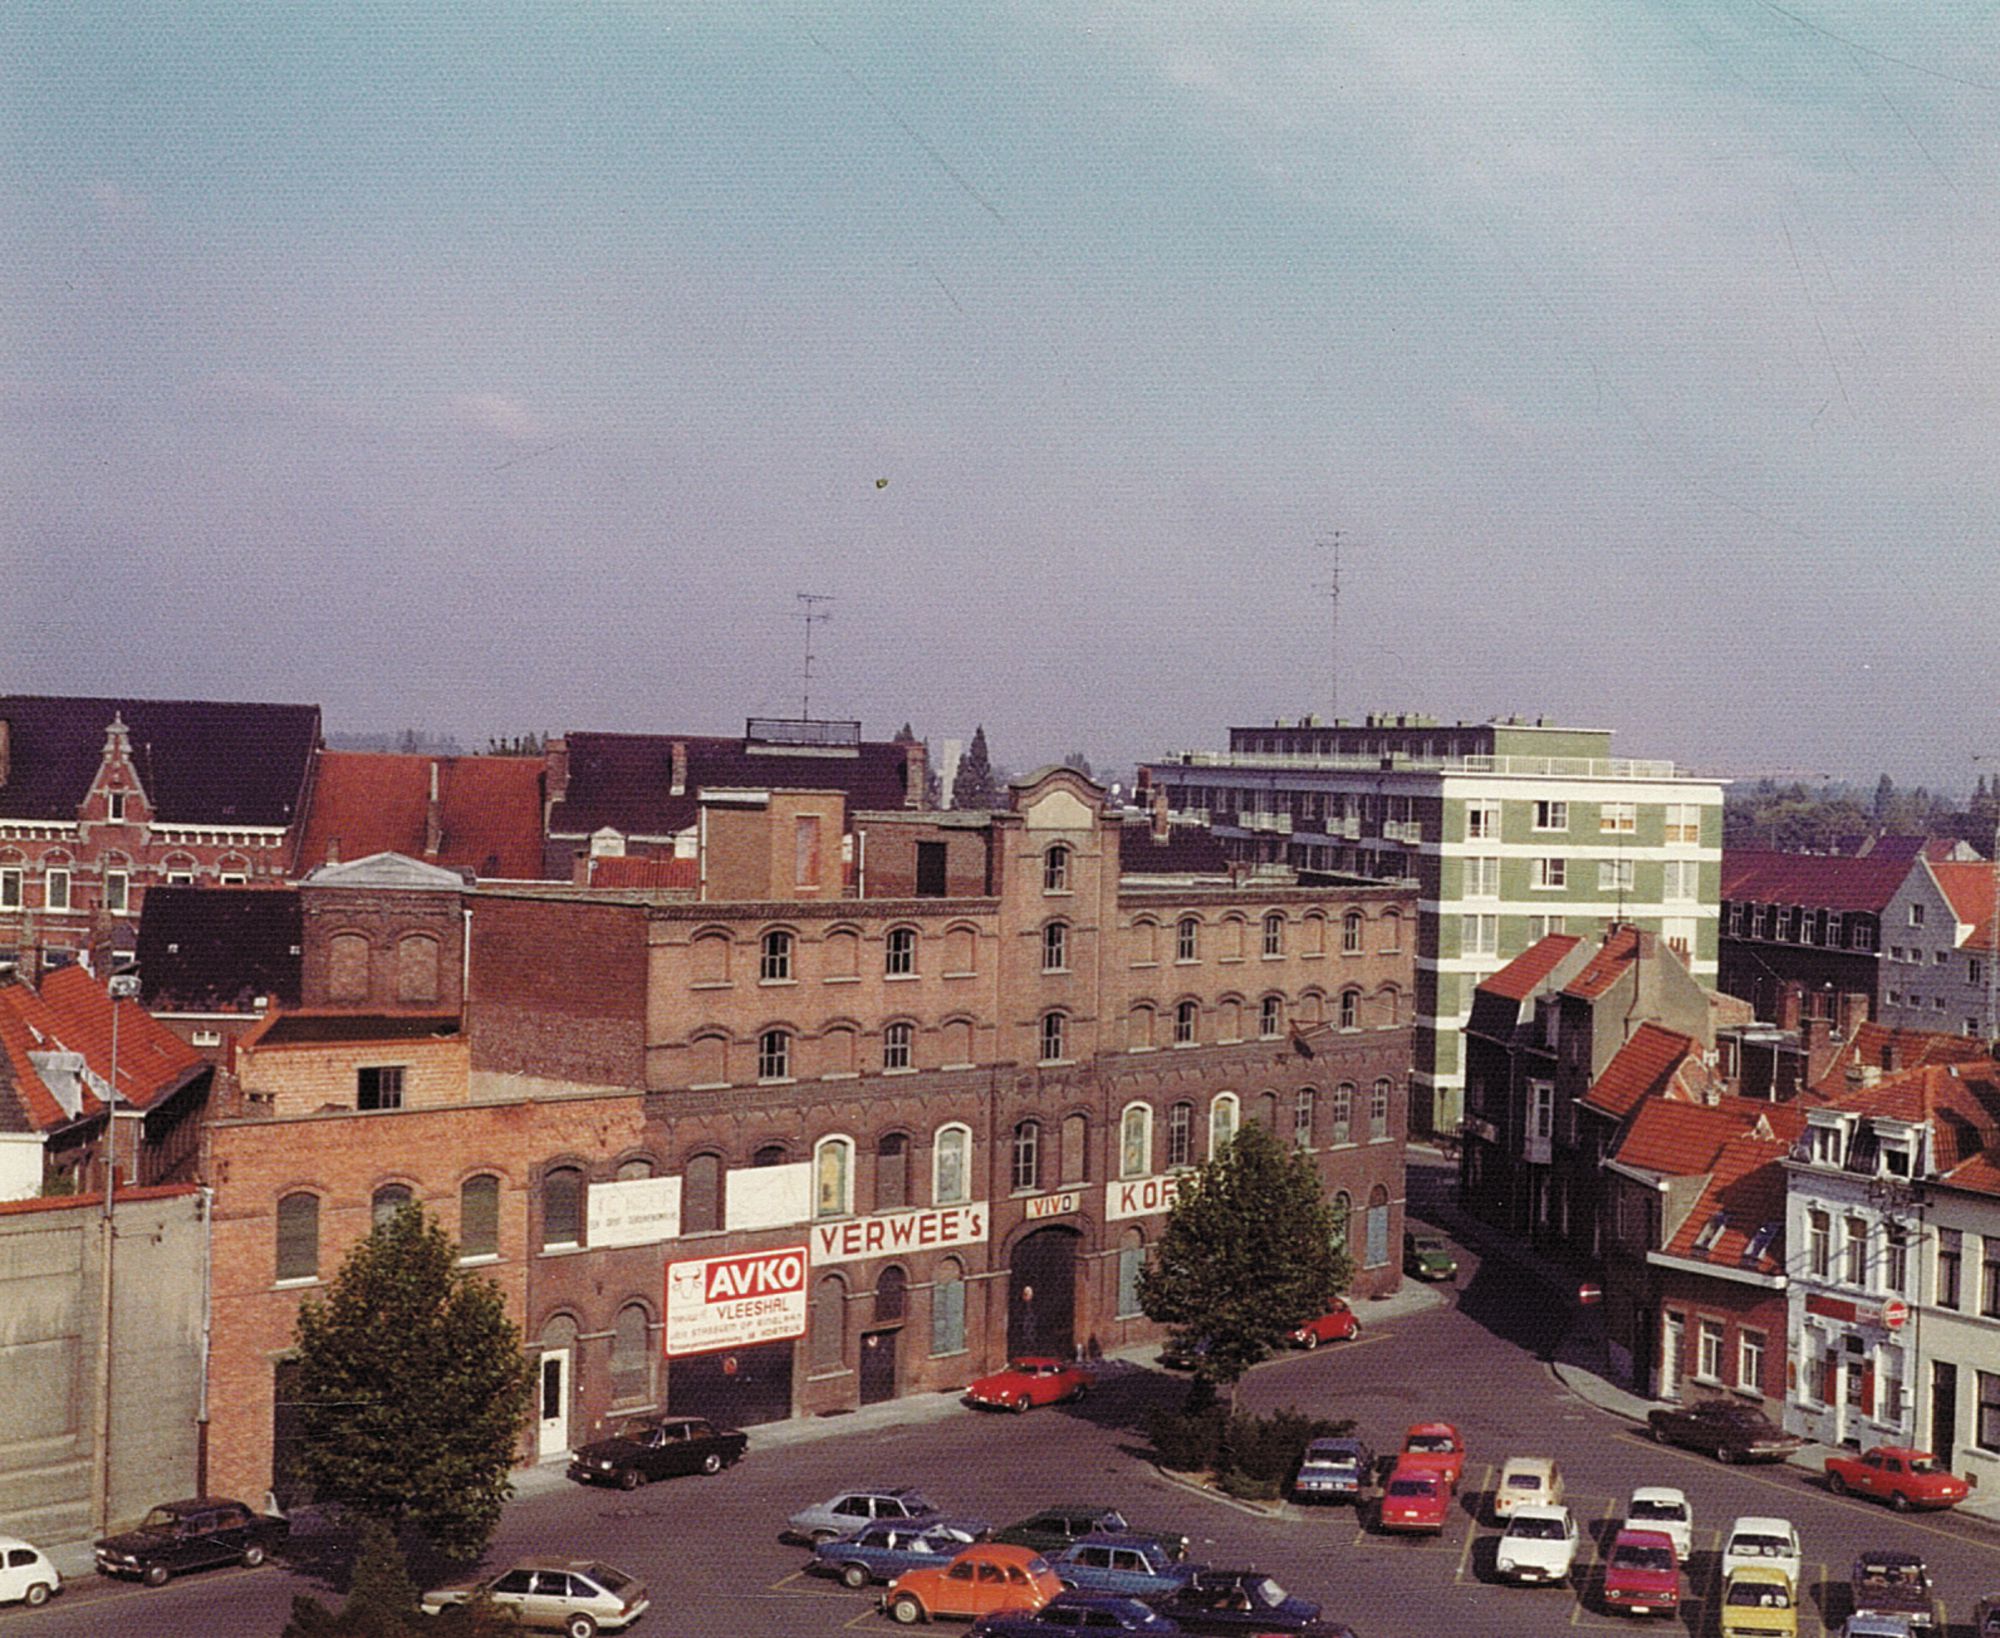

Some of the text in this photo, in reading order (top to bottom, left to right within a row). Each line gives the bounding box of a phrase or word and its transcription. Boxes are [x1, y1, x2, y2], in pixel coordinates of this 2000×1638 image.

[1033, 1195, 1072, 1216] VIVO
[708, 1256, 801, 1299] AVKO
[716, 1297, 789, 1320] VLEESHAL
